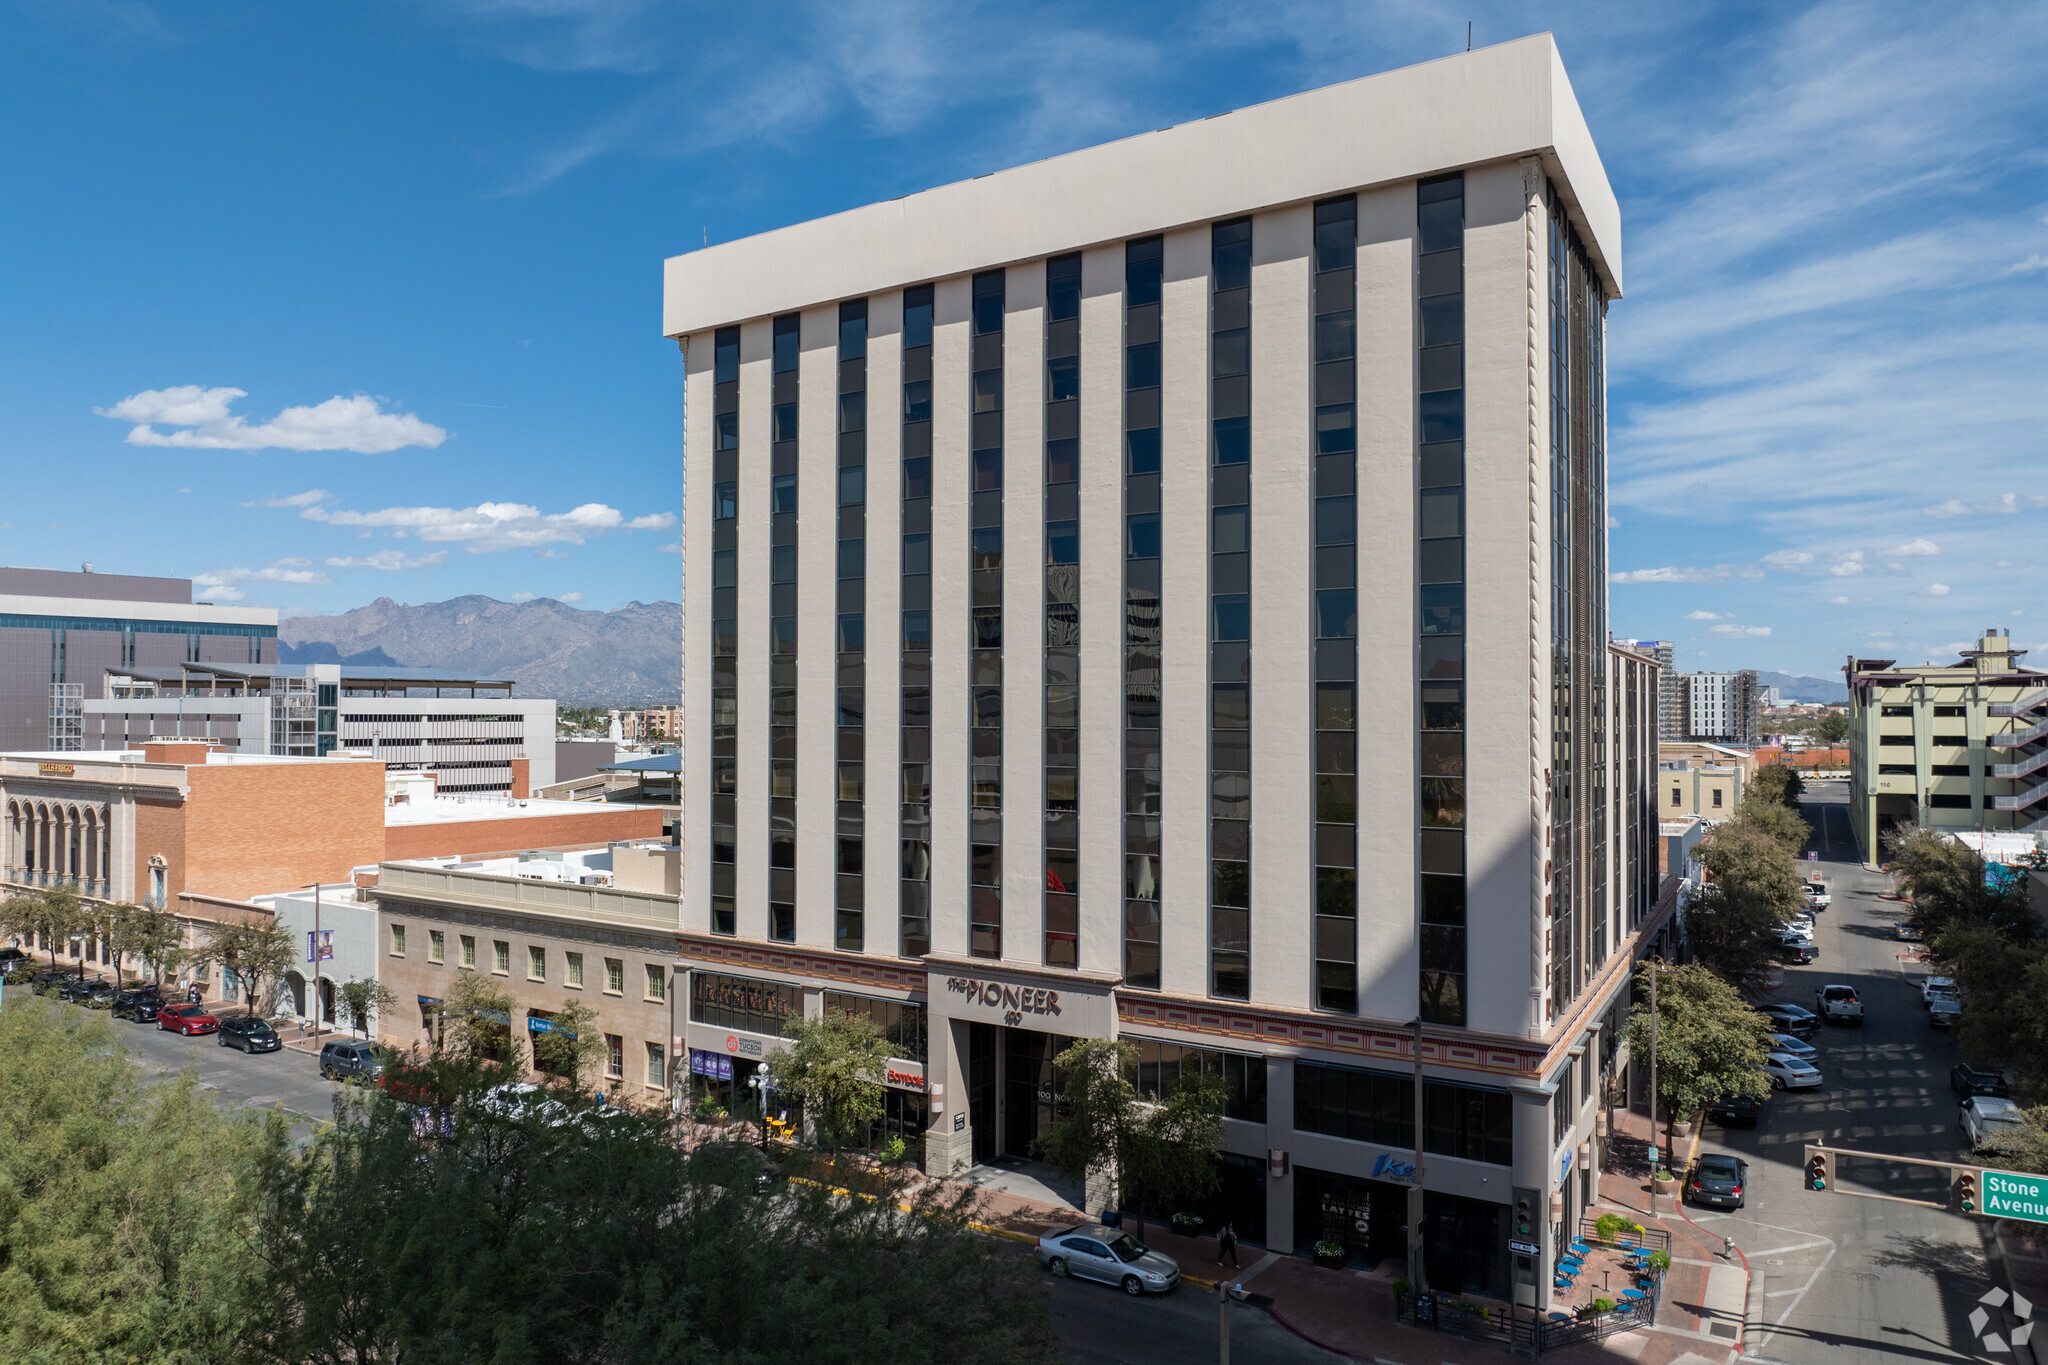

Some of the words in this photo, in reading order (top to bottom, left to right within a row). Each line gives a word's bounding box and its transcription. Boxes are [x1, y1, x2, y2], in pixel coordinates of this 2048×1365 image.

[55, 764, 73, 773] FARGO
[949, 977, 968, 988] THE
[968, 980, 1062, 1012] PIONEER
[1006, 1010, 1023, 1022] 100
[739, 1037, 762, 1046] DOWNTOWN
[739, 1042, 762, 1052] TUCSON
[1037, 1090, 1051, 1099] 100
[1989, 1177, 2039, 1197] Stone
[1322, 1204, 1370, 1220] LATTES
